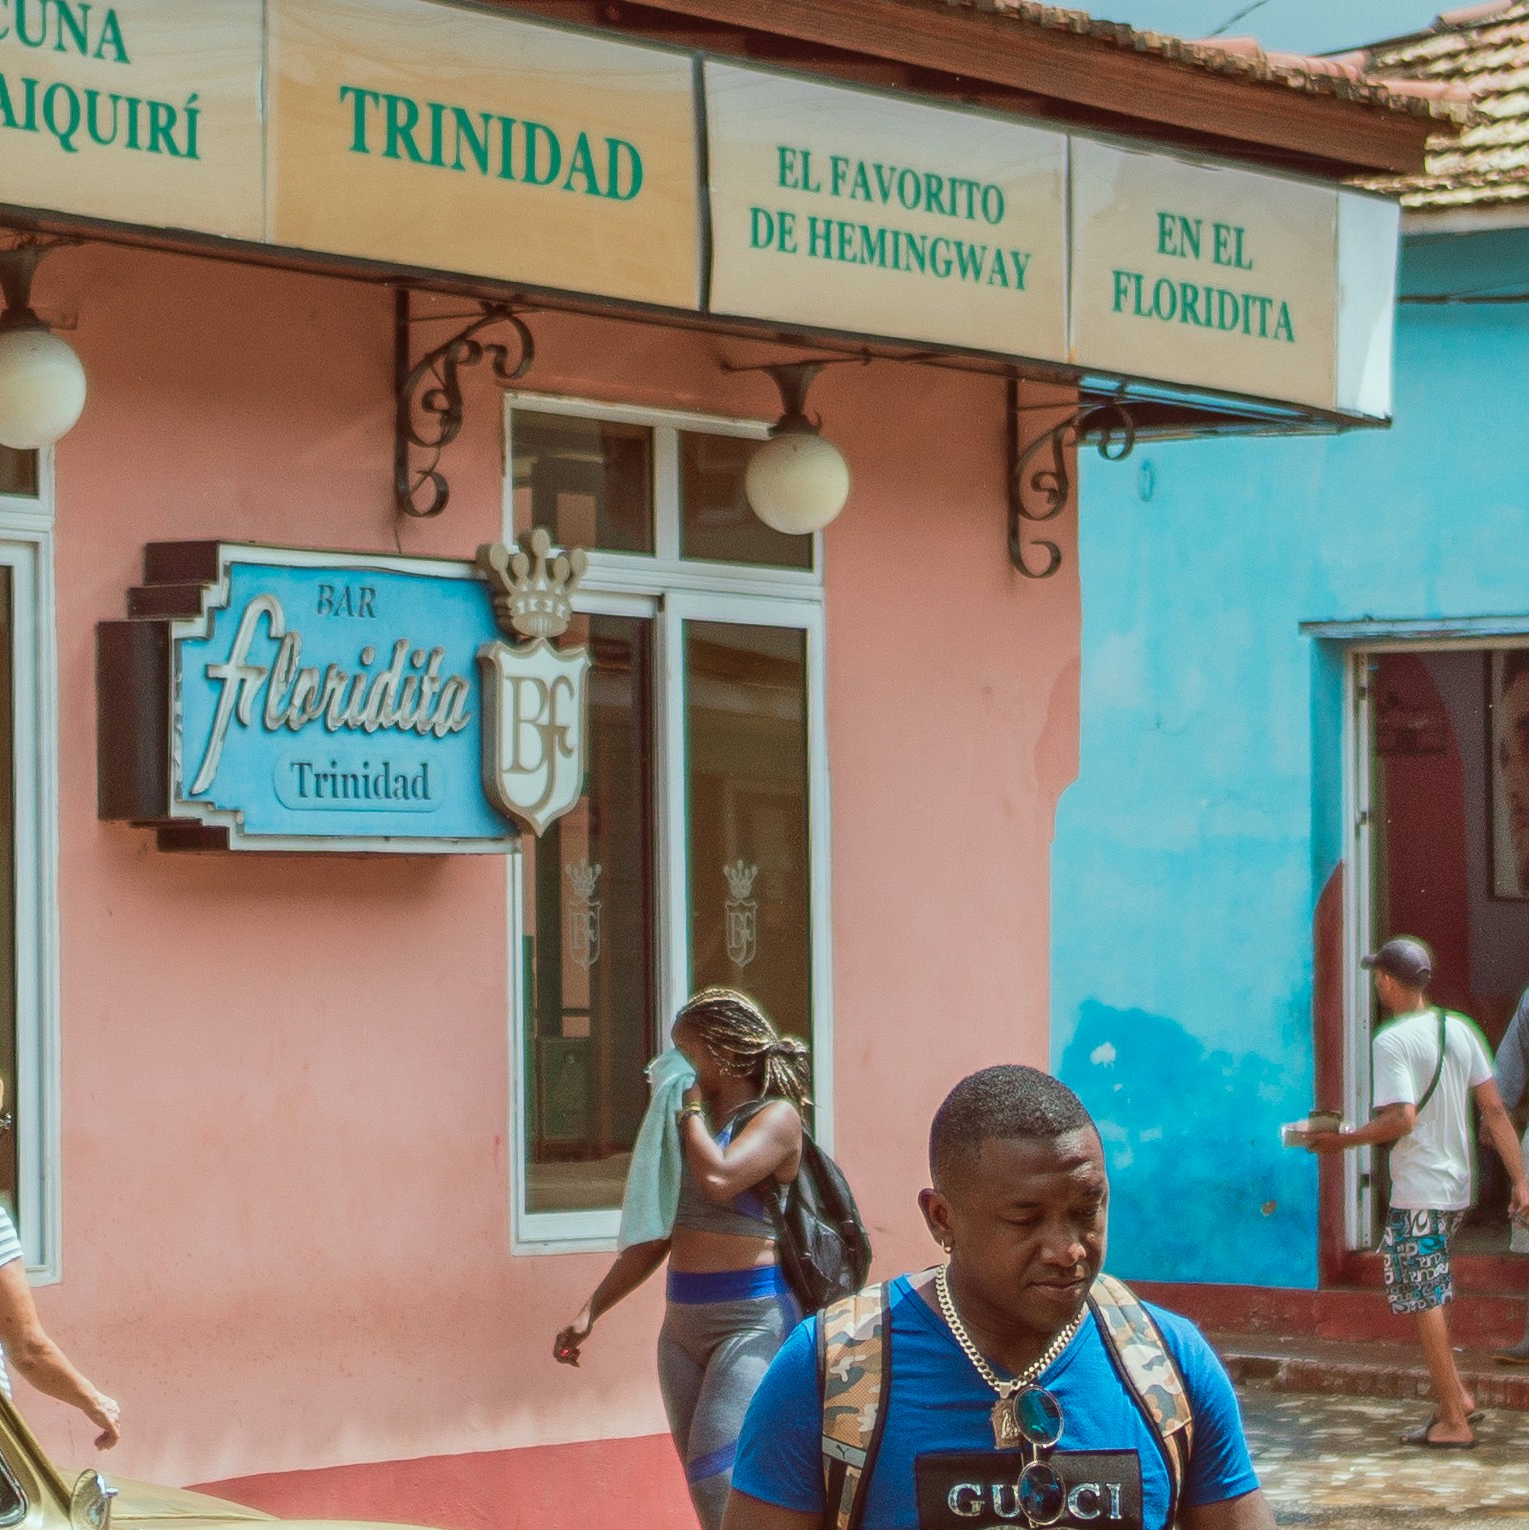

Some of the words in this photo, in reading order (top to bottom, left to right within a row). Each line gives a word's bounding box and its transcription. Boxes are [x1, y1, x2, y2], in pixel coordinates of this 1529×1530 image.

[339, 84, 644, 202] TRINIDAD
[776, 144, 823, 194] EL
[829, 154, 1006, 225] FAVORITO
[749, 206, 799, 255] DE
[806, 215, 1032, 292] HEMINGWAY
[1157, 210, 1204, 261] EN
[1212, 221, 1255, 271] EL
[1111, 268, 1296, 344] FLORIDITA
[316, 583, 378, 619] BAR
[289, 761, 432, 801] Trinidad
[947, 1483, 1122, 1520] GUCI
